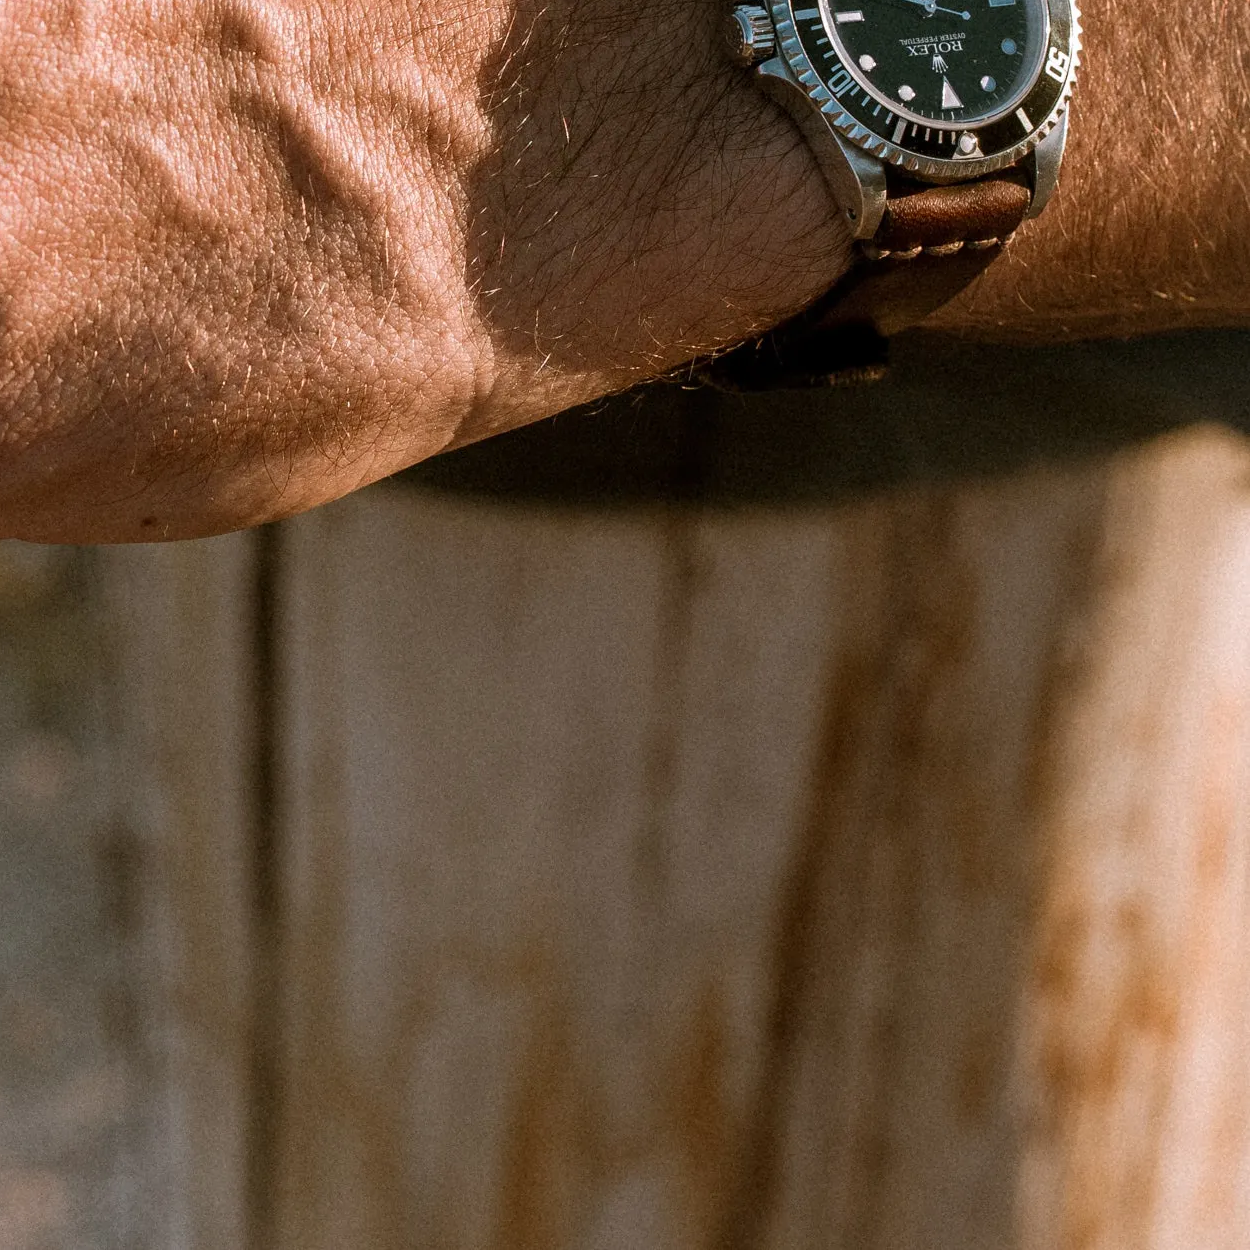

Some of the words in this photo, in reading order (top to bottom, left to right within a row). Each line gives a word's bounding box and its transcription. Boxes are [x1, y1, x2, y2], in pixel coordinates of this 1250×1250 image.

[899, 35, 939, 46] PERPETUAL
[940, 33, 966, 42] OYSTER
[907, 40, 963, 56] ROLEX
[1045, 47, 1070, 82] 50
[828, 69, 857, 98] 10
